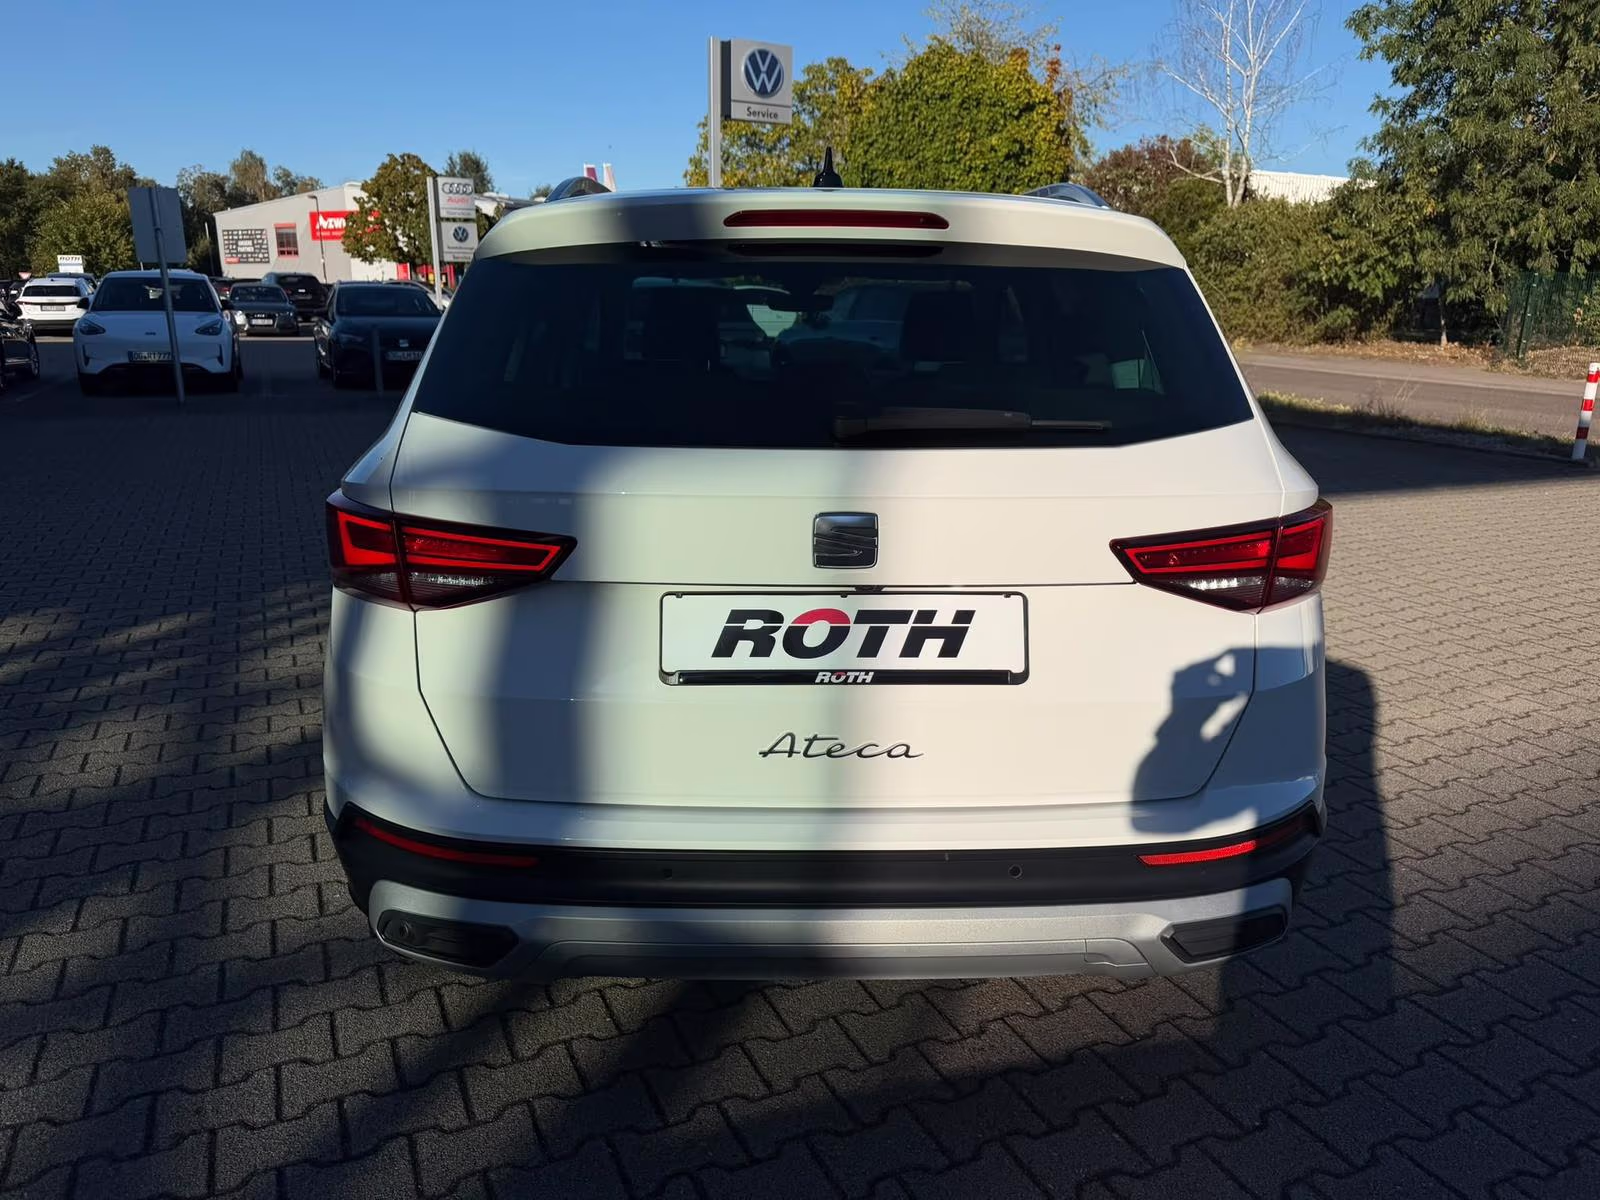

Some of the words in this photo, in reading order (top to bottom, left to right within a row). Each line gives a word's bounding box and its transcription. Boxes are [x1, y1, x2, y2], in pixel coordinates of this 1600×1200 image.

[746, 106, 779, 119] Service
[711, 608, 976, 660] ROTH
[814, 671, 874, 684] ROTH
[758, 731, 924, 759] Ateca
